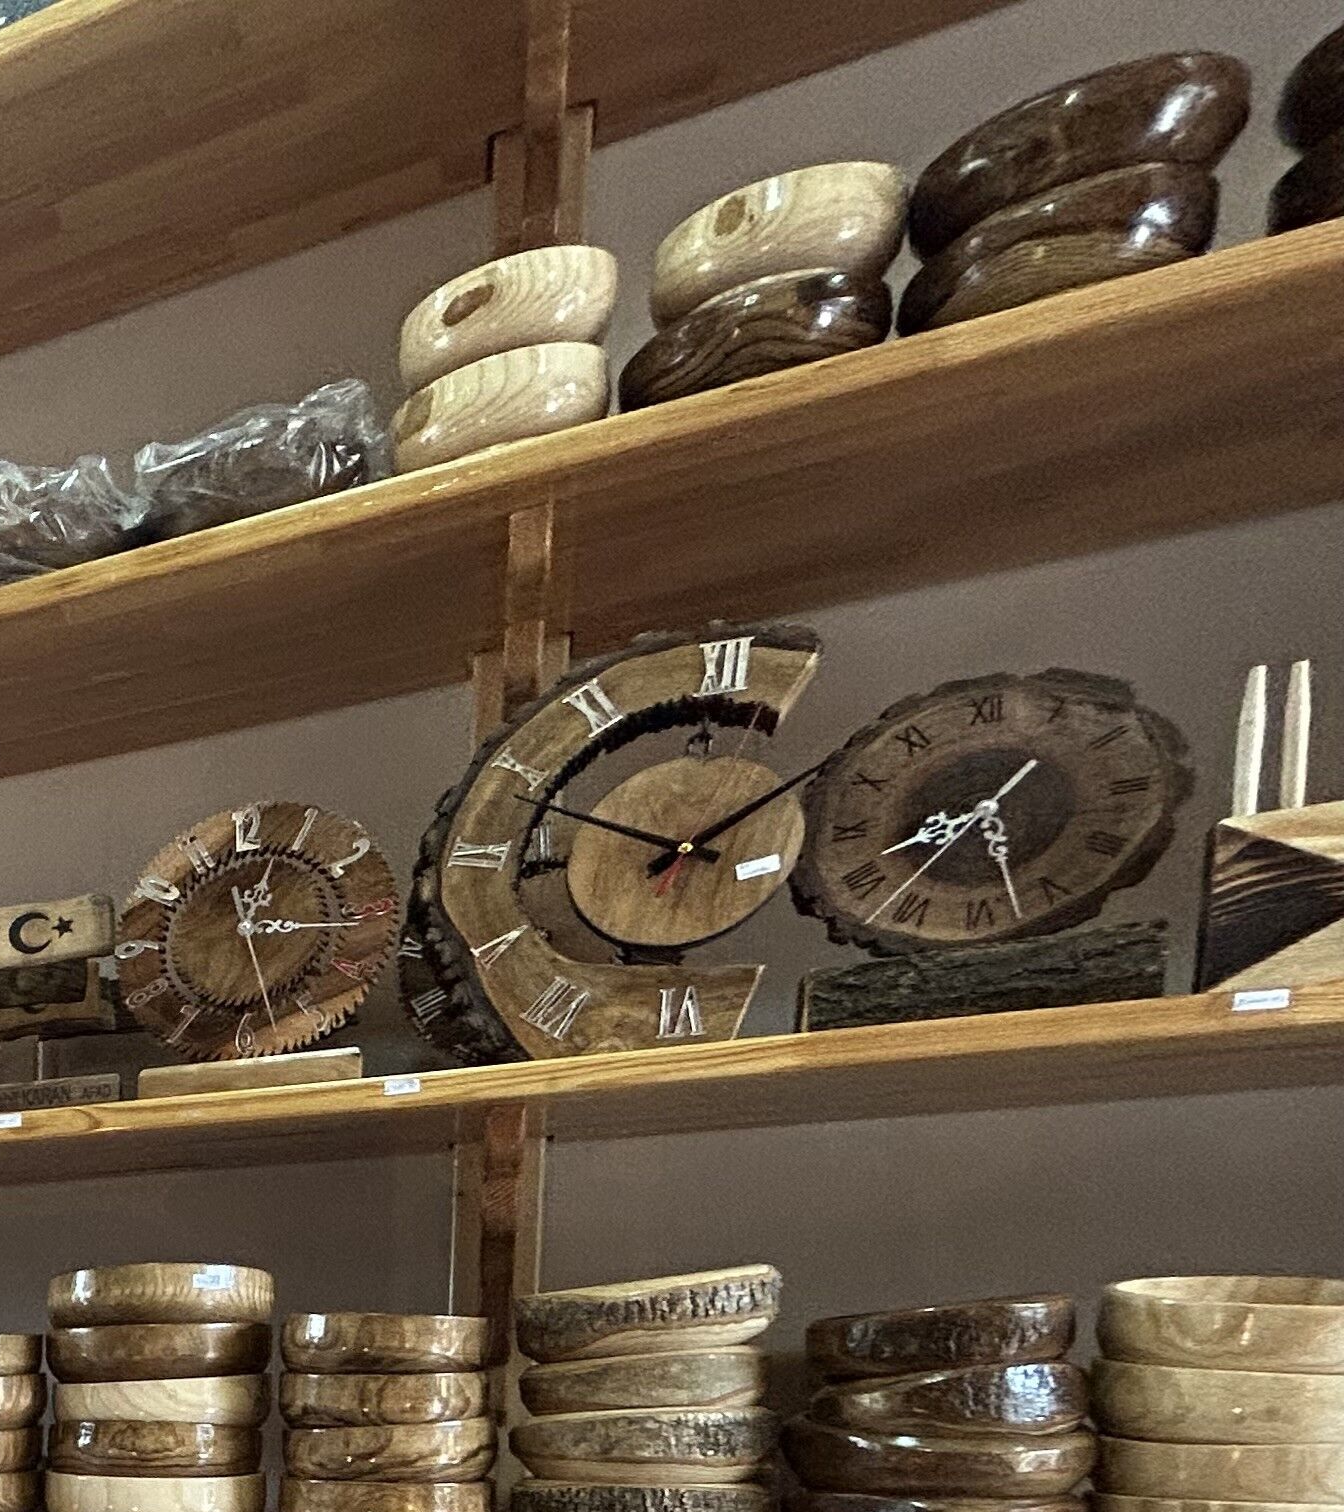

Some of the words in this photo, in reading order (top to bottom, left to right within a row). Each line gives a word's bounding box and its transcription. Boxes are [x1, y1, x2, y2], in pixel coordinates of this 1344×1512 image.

[693, 635, 755, 698] XII
[562, 678, 625, 739] XI
[968, 696, 1005, 727] XII
[231, 806, 262, 853] 12
[292, 807, 319, 851] 1
[328, 837, 372, 880] 2
[113, 939, 160, 960] 9
[124, 976, 169, 1010] 8
[163, 1004, 202, 1044] 7
[234, 1012, 257, 1056] 6
